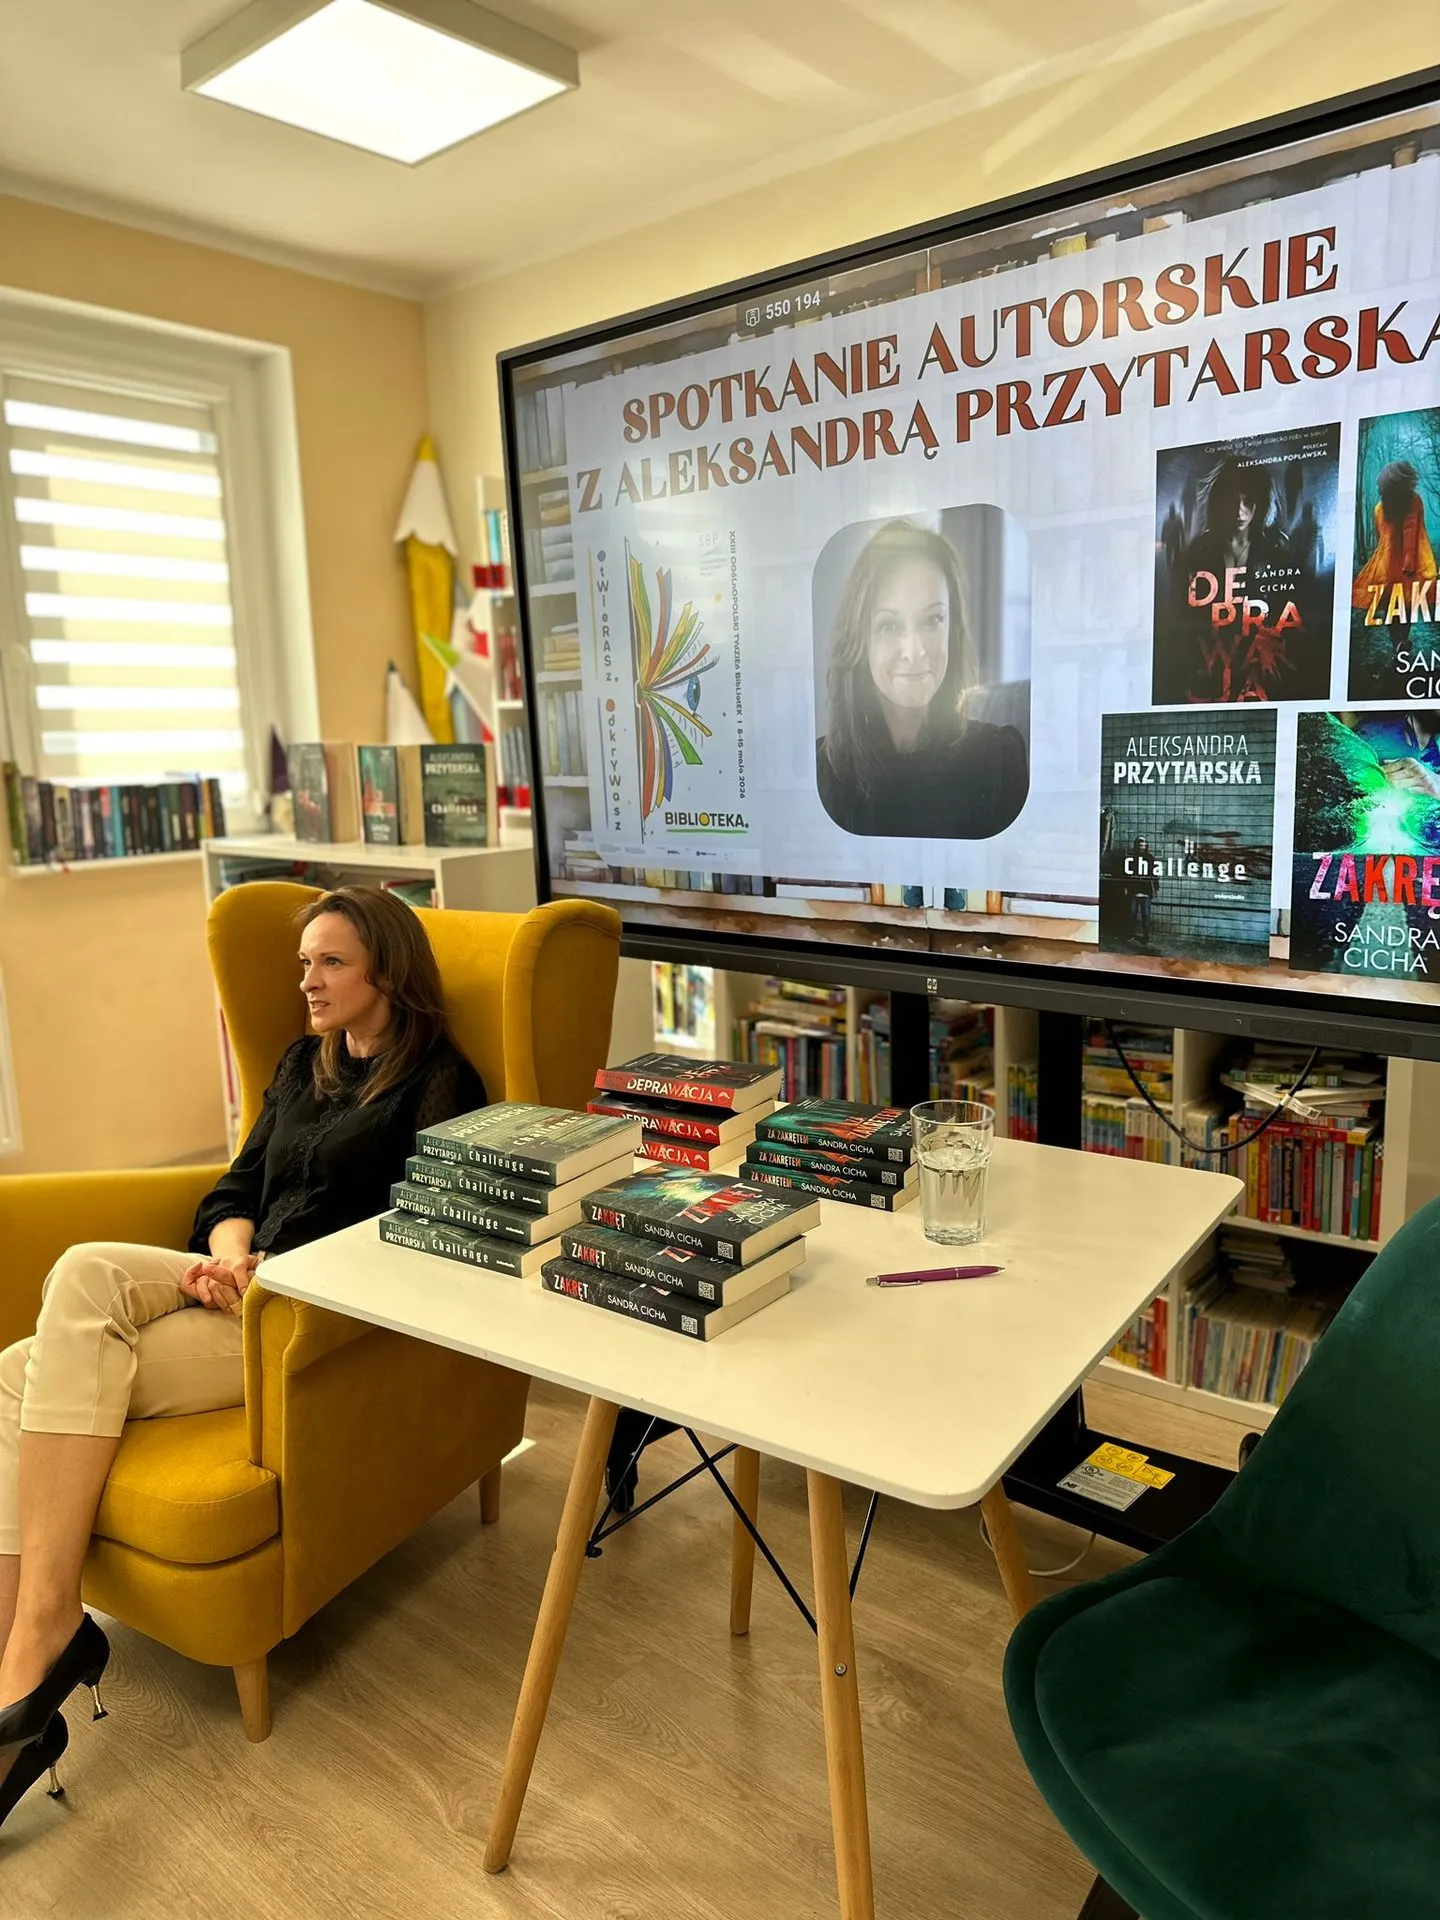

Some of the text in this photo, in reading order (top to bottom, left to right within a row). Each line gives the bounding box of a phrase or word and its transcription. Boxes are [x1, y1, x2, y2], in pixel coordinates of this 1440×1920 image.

[766, 290, 821, 320] 550 194
[622, 226, 1337, 443] SPOTKANIE AUTORSKIE
[576, 467, 603, 514] Z
[614, 399, 940, 507] ALEKSANDRĄ
[1237, 456, 1283, 468] ALEKSANDRA
[1254, 568, 1301, 580] SANDRA
[1259, 583, 1296, 593] CICHA
[1126, 734, 1249, 757] ALEKSANDRA
[1113, 760, 1263, 785] PRZYTARSKA
[1124, 856, 1248, 883] Challenge
[1334, 922, 1440, 950] SANDRA
[1343, 947, 1428, 974] CICHA
[767, 1129, 776, 1139] ZA
[818, 1138, 849, 1151] SANDRA
[849, 1143, 874, 1155] CICHA
[468, 1151, 524, 1172] Challenge
[759, 1152, 767, 1162] ZA
[810, 1161, 841, 1174] SANDRA
[842, 1166, 867, 1178] CICHA
[459, 1178, 515, 1200] Challenge
[751, 1171, 759, 1181] ZA
[801, 1183, 831, 1196] SANDRA
[832, 1188, 857, 1201] CICHA
[442, 1206, 498, 1230] Challenge
[591, 1205, 703, 1248] ZAKRĘT SANDRA CICHA
[748, 1203, 791, 1225] CICHA
[432, 1240, 489, 1264] Challenge
[571, 1242, 684, 1288] ZAKRĘT SANDRA CICHA
[554, 1274, 667, 1321] ZAKRĘT SANDRA CICHA
